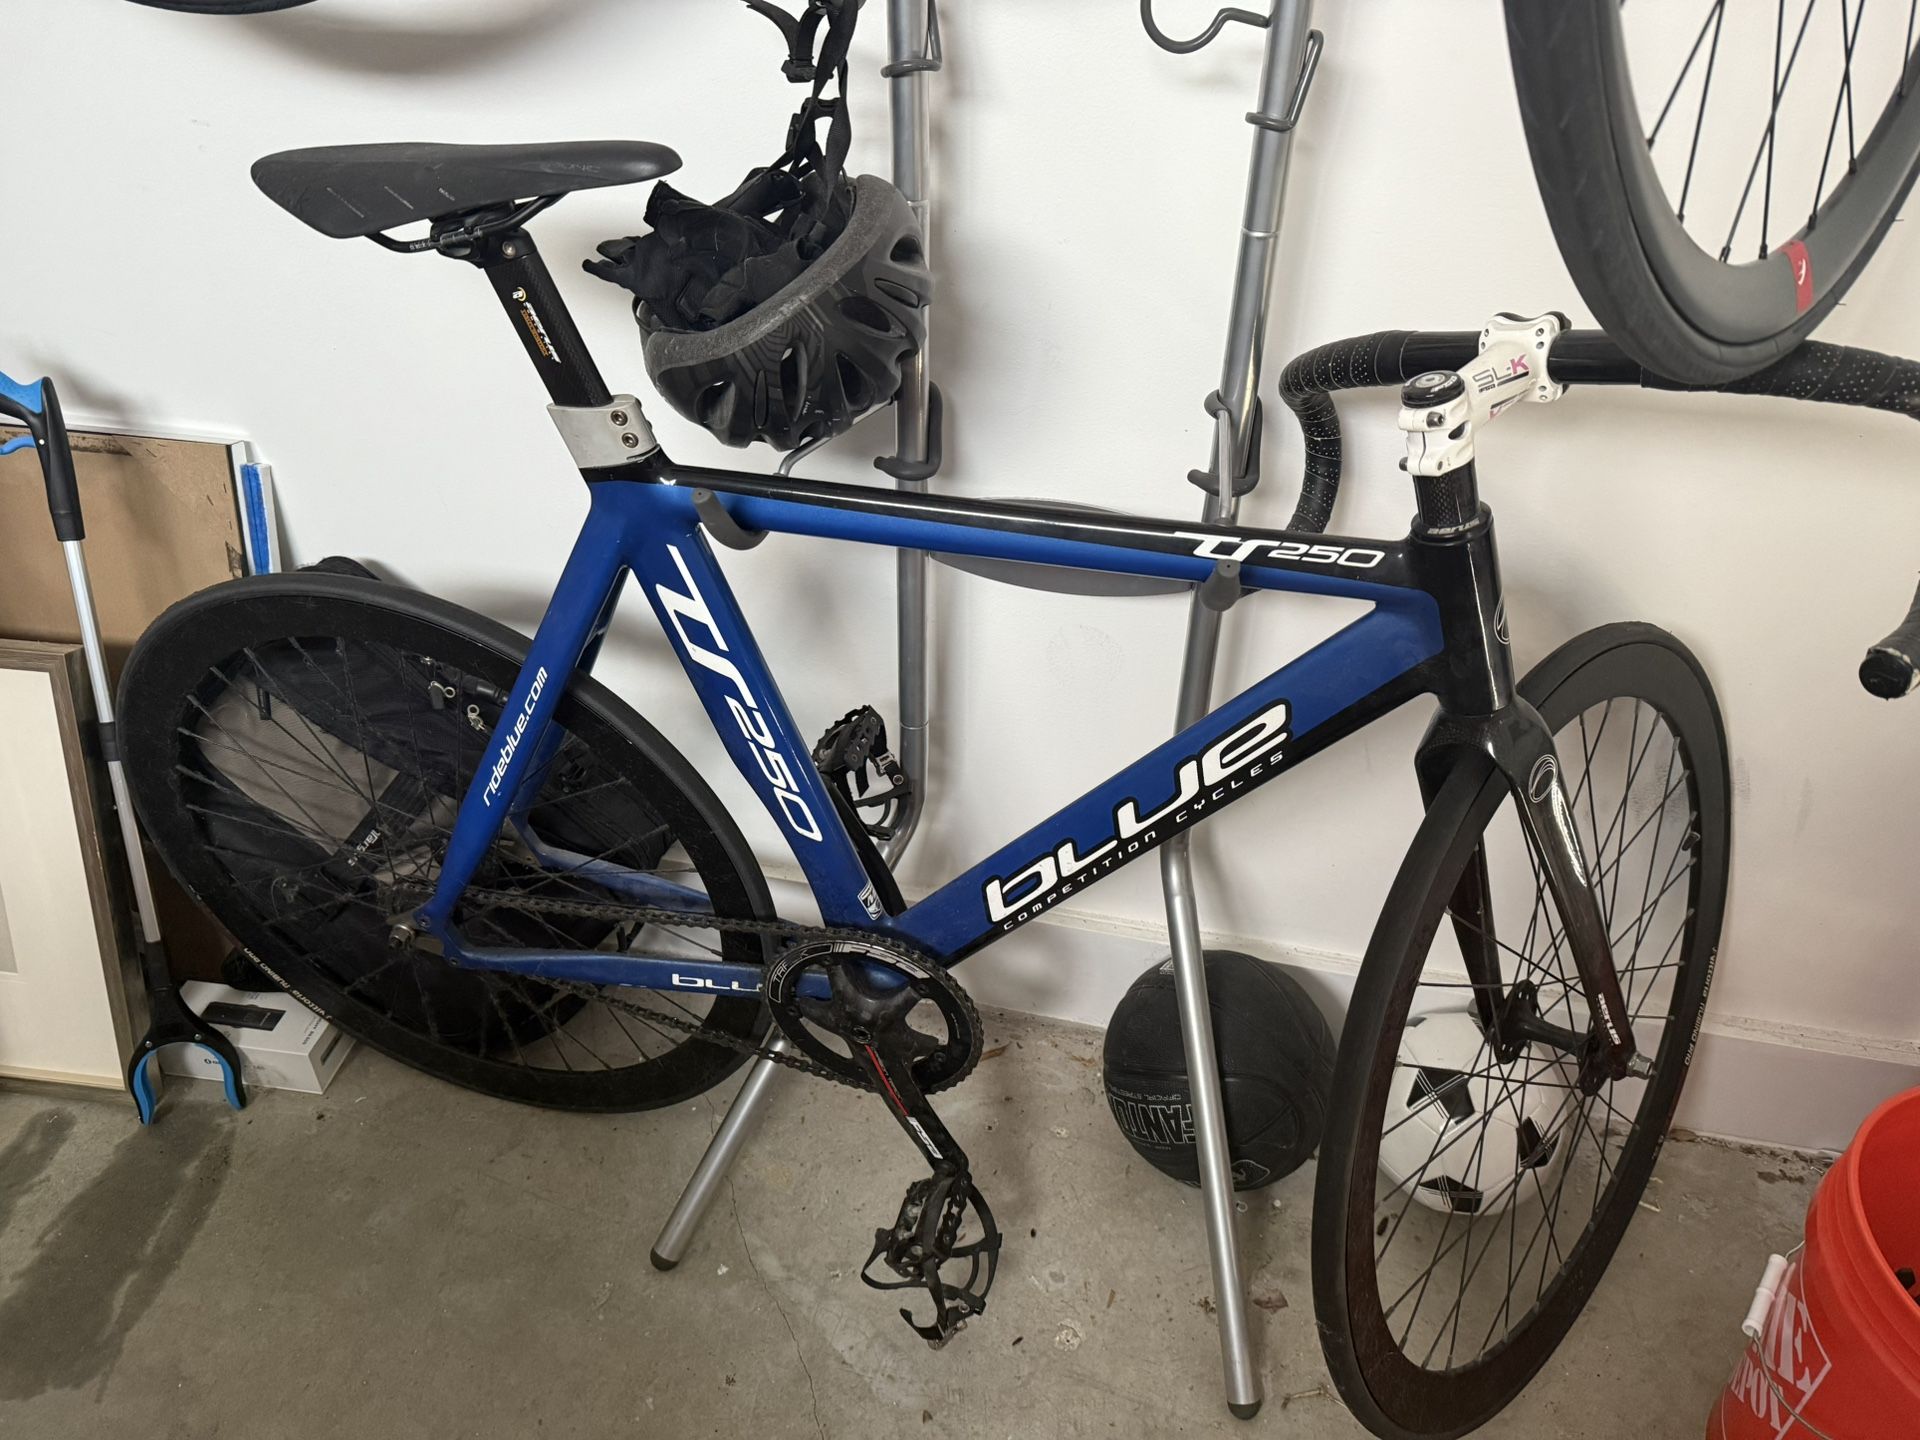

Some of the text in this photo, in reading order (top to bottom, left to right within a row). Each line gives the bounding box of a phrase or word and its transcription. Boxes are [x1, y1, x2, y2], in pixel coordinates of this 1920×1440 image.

[483, 666, 548, 807] rideblue.com
[1003, 750, 1284, 931] COMPETITION CYCLES
[1597, 992, 1622, 1046] aerus
[904, 1115, 943, 1160] FSA
